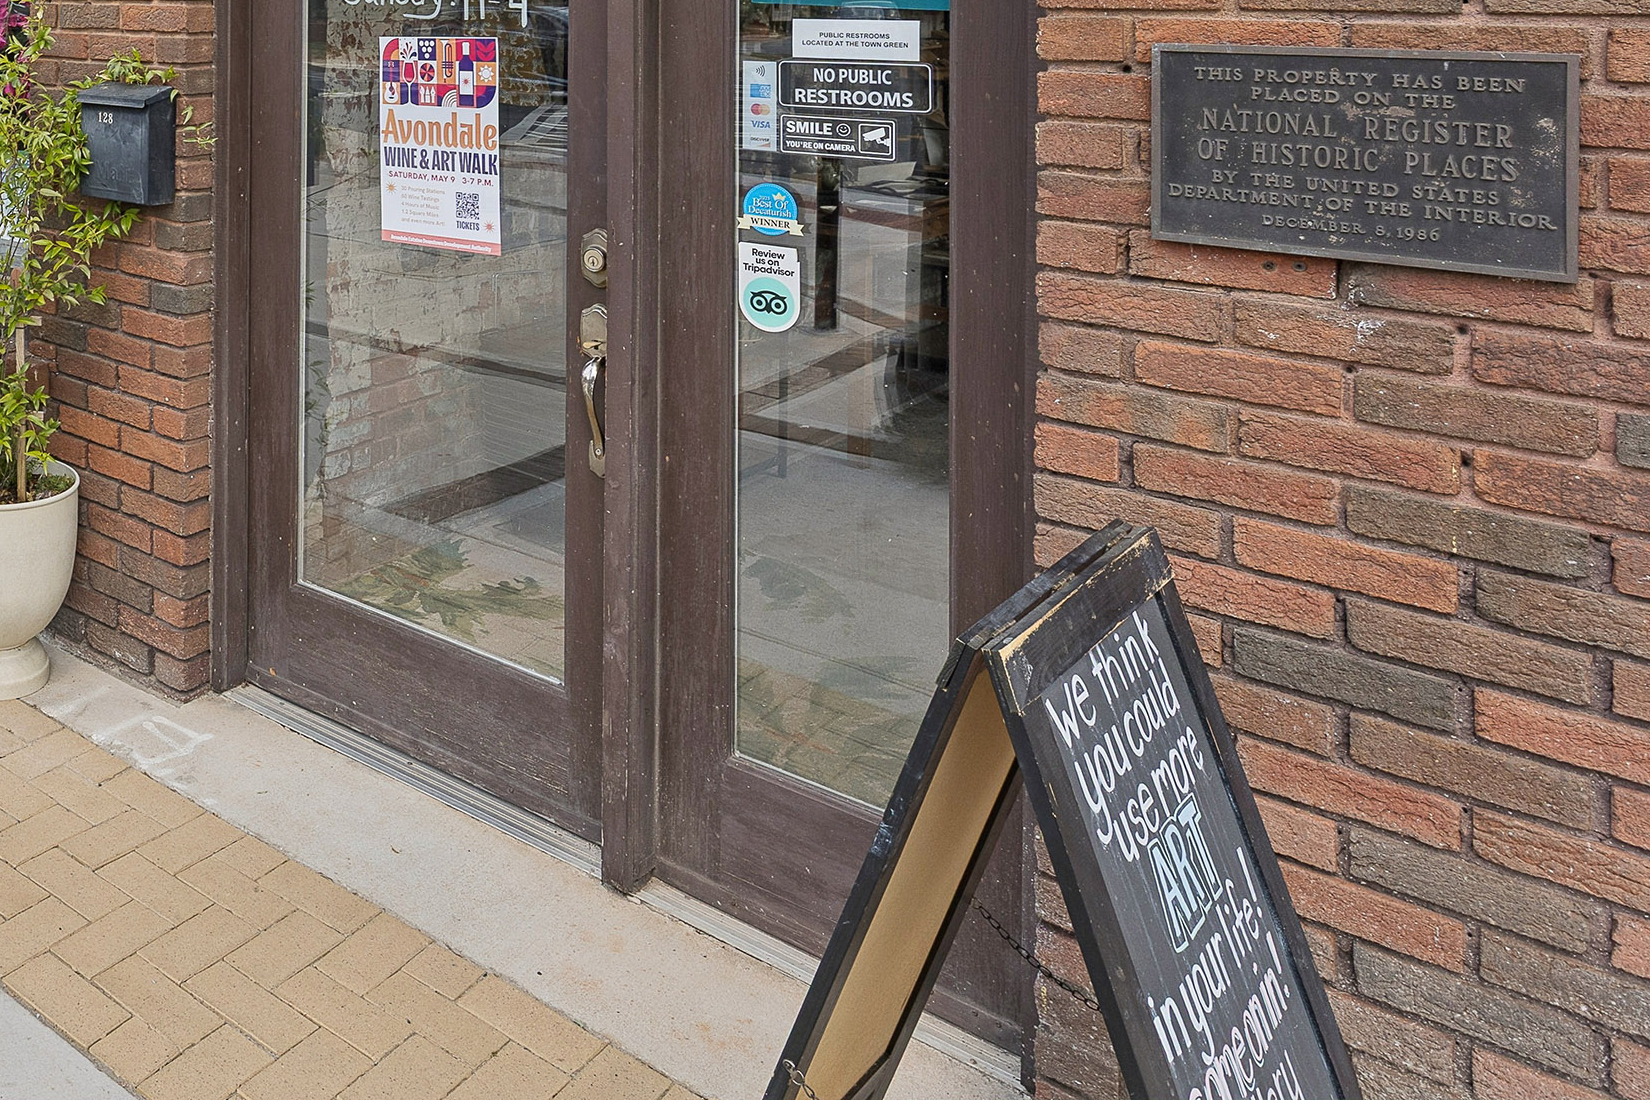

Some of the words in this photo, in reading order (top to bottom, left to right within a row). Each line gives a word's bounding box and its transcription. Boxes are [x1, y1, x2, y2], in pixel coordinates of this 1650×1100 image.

[819, 31, 844, 39] PUBLIC
[845, 32, 890, 40] RESTROOMS
[845, 40, 859, 48] THE
[882, 41, 910, 49] GREEN
[813, 67, 836, 83] NO
[838, 68, 892, 85] PUBLIC
[1194, 66, 1244, 82] THIS
[1253, 68, 1378, 87] PROPERTY
[1391, 73, 1443, 90] HAS
[1456, 76, 1526, 94] BEEN
[794, 88, 914, 108] RESTROOMS
[1251, 86, 1341, 104] PLACED
[1353, 91, 1392, 107] ON
[1404, 93, 1457, 110] THE
[97, 112, 114, 125] 128
[750, 120, 771, 129] VISA
[785, 120, 833, 136] SMILE
[1201, 107, 1338, 138] NATIONAL
[1363, 116, 1514, 149] REGISTER
[380, 108, 498, 152] Avondale
[785, 139, 812, 149] YOU'RE
[813, 140, 825, 150] ON
[824, 141, 857, 153] CAMERA
[384, 146, 418, 169] WINE
[419, 148, 430, 170] &
[431, 149, 458, 173] ART
[458, 151, 499, 176] WALK
[1197, 137, 1230, 161] OF
[1250, 141, 1379, 172] HISTORIC
[1403, 151, 1521, 183] PLACES
[388, 170, 430, 182] SATURDAY,
[430, 174, 449, 183] MAY
[461, 177, 475, 185] 3-7
[476, 178, 494, 187] P.M.
[1211, 169, 1240, 185] BY
[1250, 173, 1296, 190] THE
[1305, 176, 1400, 198] UNITED
[1411, 185, 1500, 206] STATES
[748, 205, 793, 218] Decaturish
[752, 197, 773, 209] Best
[774, 200, 789, 210] Of
[1168, 182, 1315, 209] DEPARTMENT
[1324, 197, 1355, 213] OF
[1364, 200, 1414, 218] THE
[1424, 205, 1559, 231] INTERIOR
[455, 220, 481, 232] TICKETS
[750, 216, 791, 229] WINNER
[1260, 214, 1367, 235] DECEMBER
[1374, 225, 1392, 239] 8,
[1396, 227, 1441, 242] 1986
[751, 248, 786, 260] Review
[767, 259, 780, 267] on
[742, 261, 796, 278] Tripadvisor
[1089, 610, 1160, 704] think
[1074, 724, 1133, 846] you
[1123, 657, 1181, 758] could
[1113, 783, 1160, 863] use
[1151, 726, 1205, 818] more
[1147, 792, 1226, 954] ART
[1147, 993, 1192, 1064] in
[1178, 932, 1231, 1066] your
[1214, 846, 1263, 970] life!
